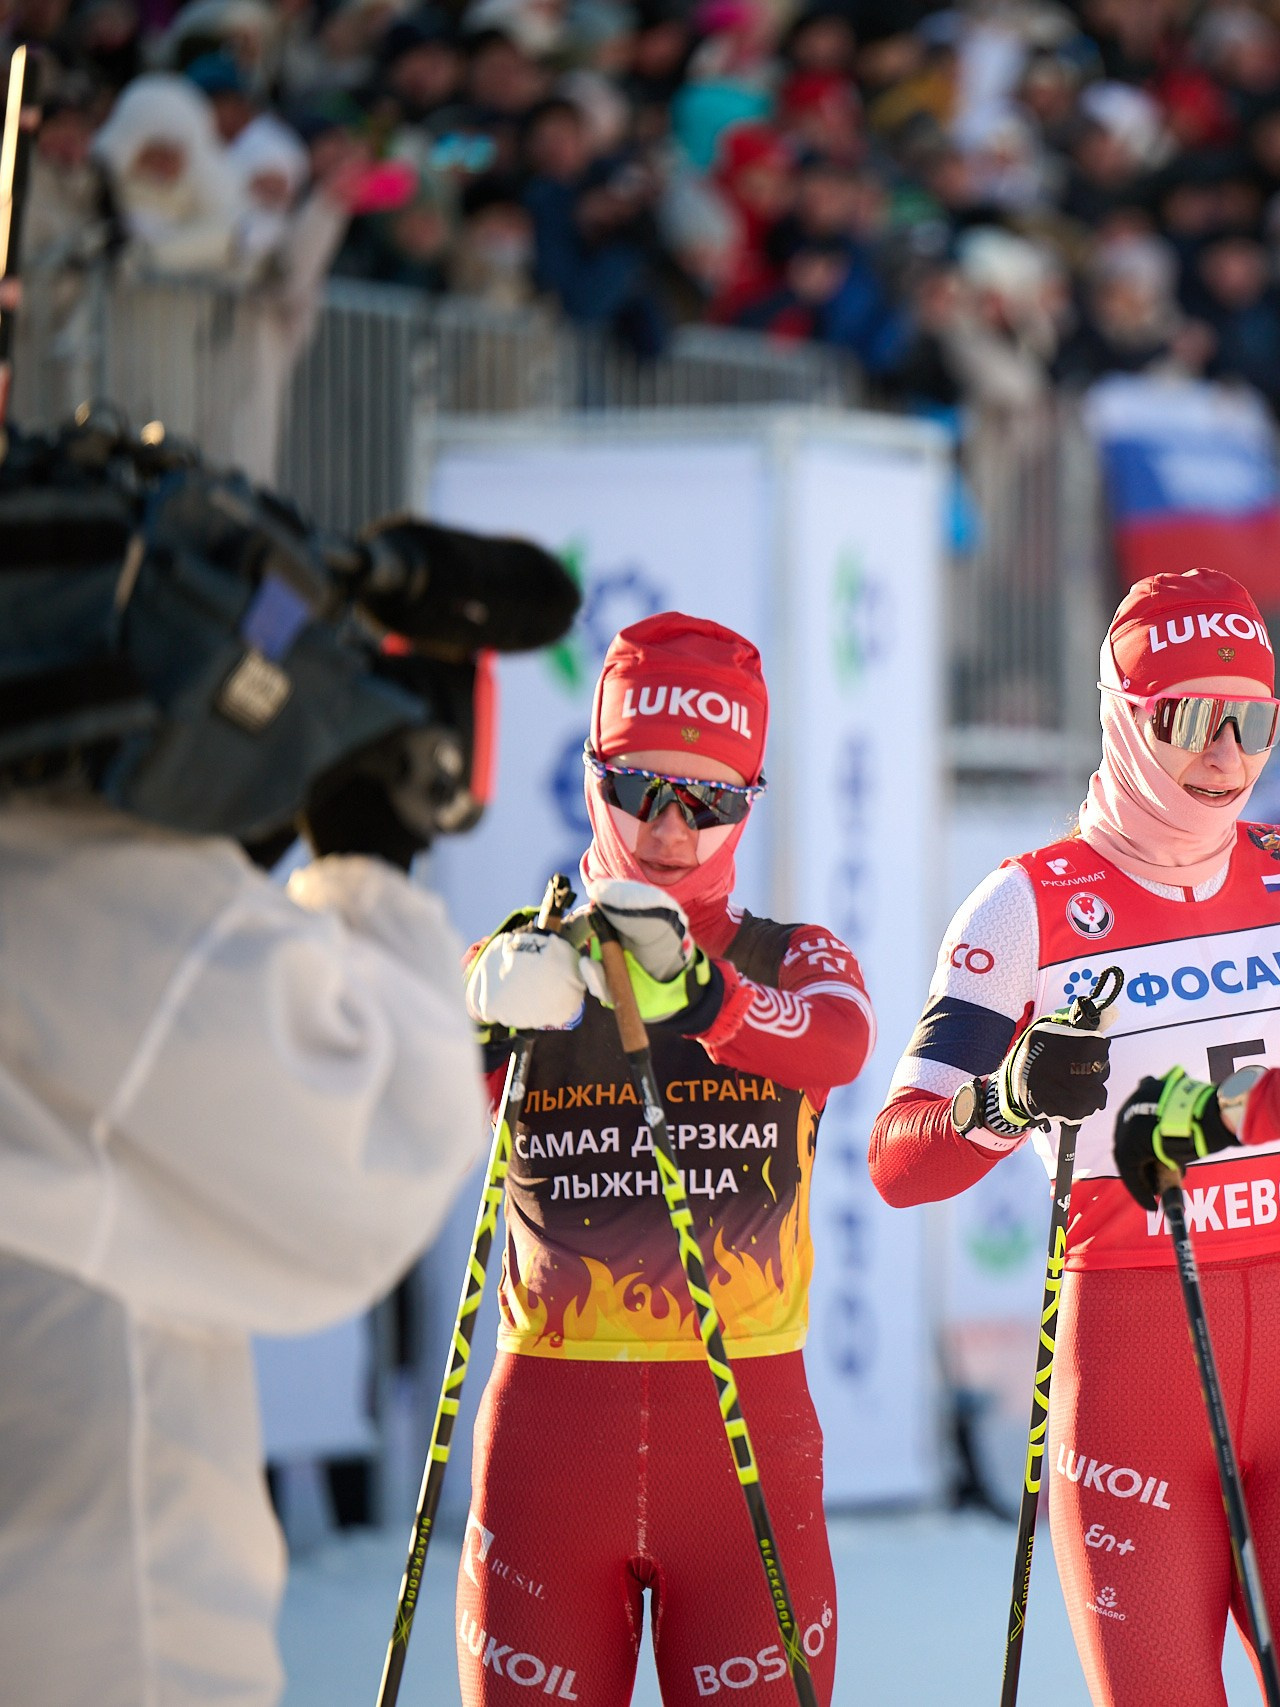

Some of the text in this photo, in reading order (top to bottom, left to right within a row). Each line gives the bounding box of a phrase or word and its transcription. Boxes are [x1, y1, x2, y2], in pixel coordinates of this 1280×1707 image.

[1149, 612, 1274, 654] LUKOIL
[621, 686, 752, 740] LUKOIL
[1041, 870, 1107, 888] РУСКЛИМАТ
[524, 1081, 645, 1114] ЛЫЖНА
[666, 1078, 776, 1103] СТРАНА
[516, 1127, 620, 1159] САМАЯ
[1056, 1443, 1171, 1511] LUKOIL
[490, 1557, 546, 1600] RUSAL
[459, 1609, 579, 1701] LUKOIL
[693, 1622, 825, 1697] BOSO
